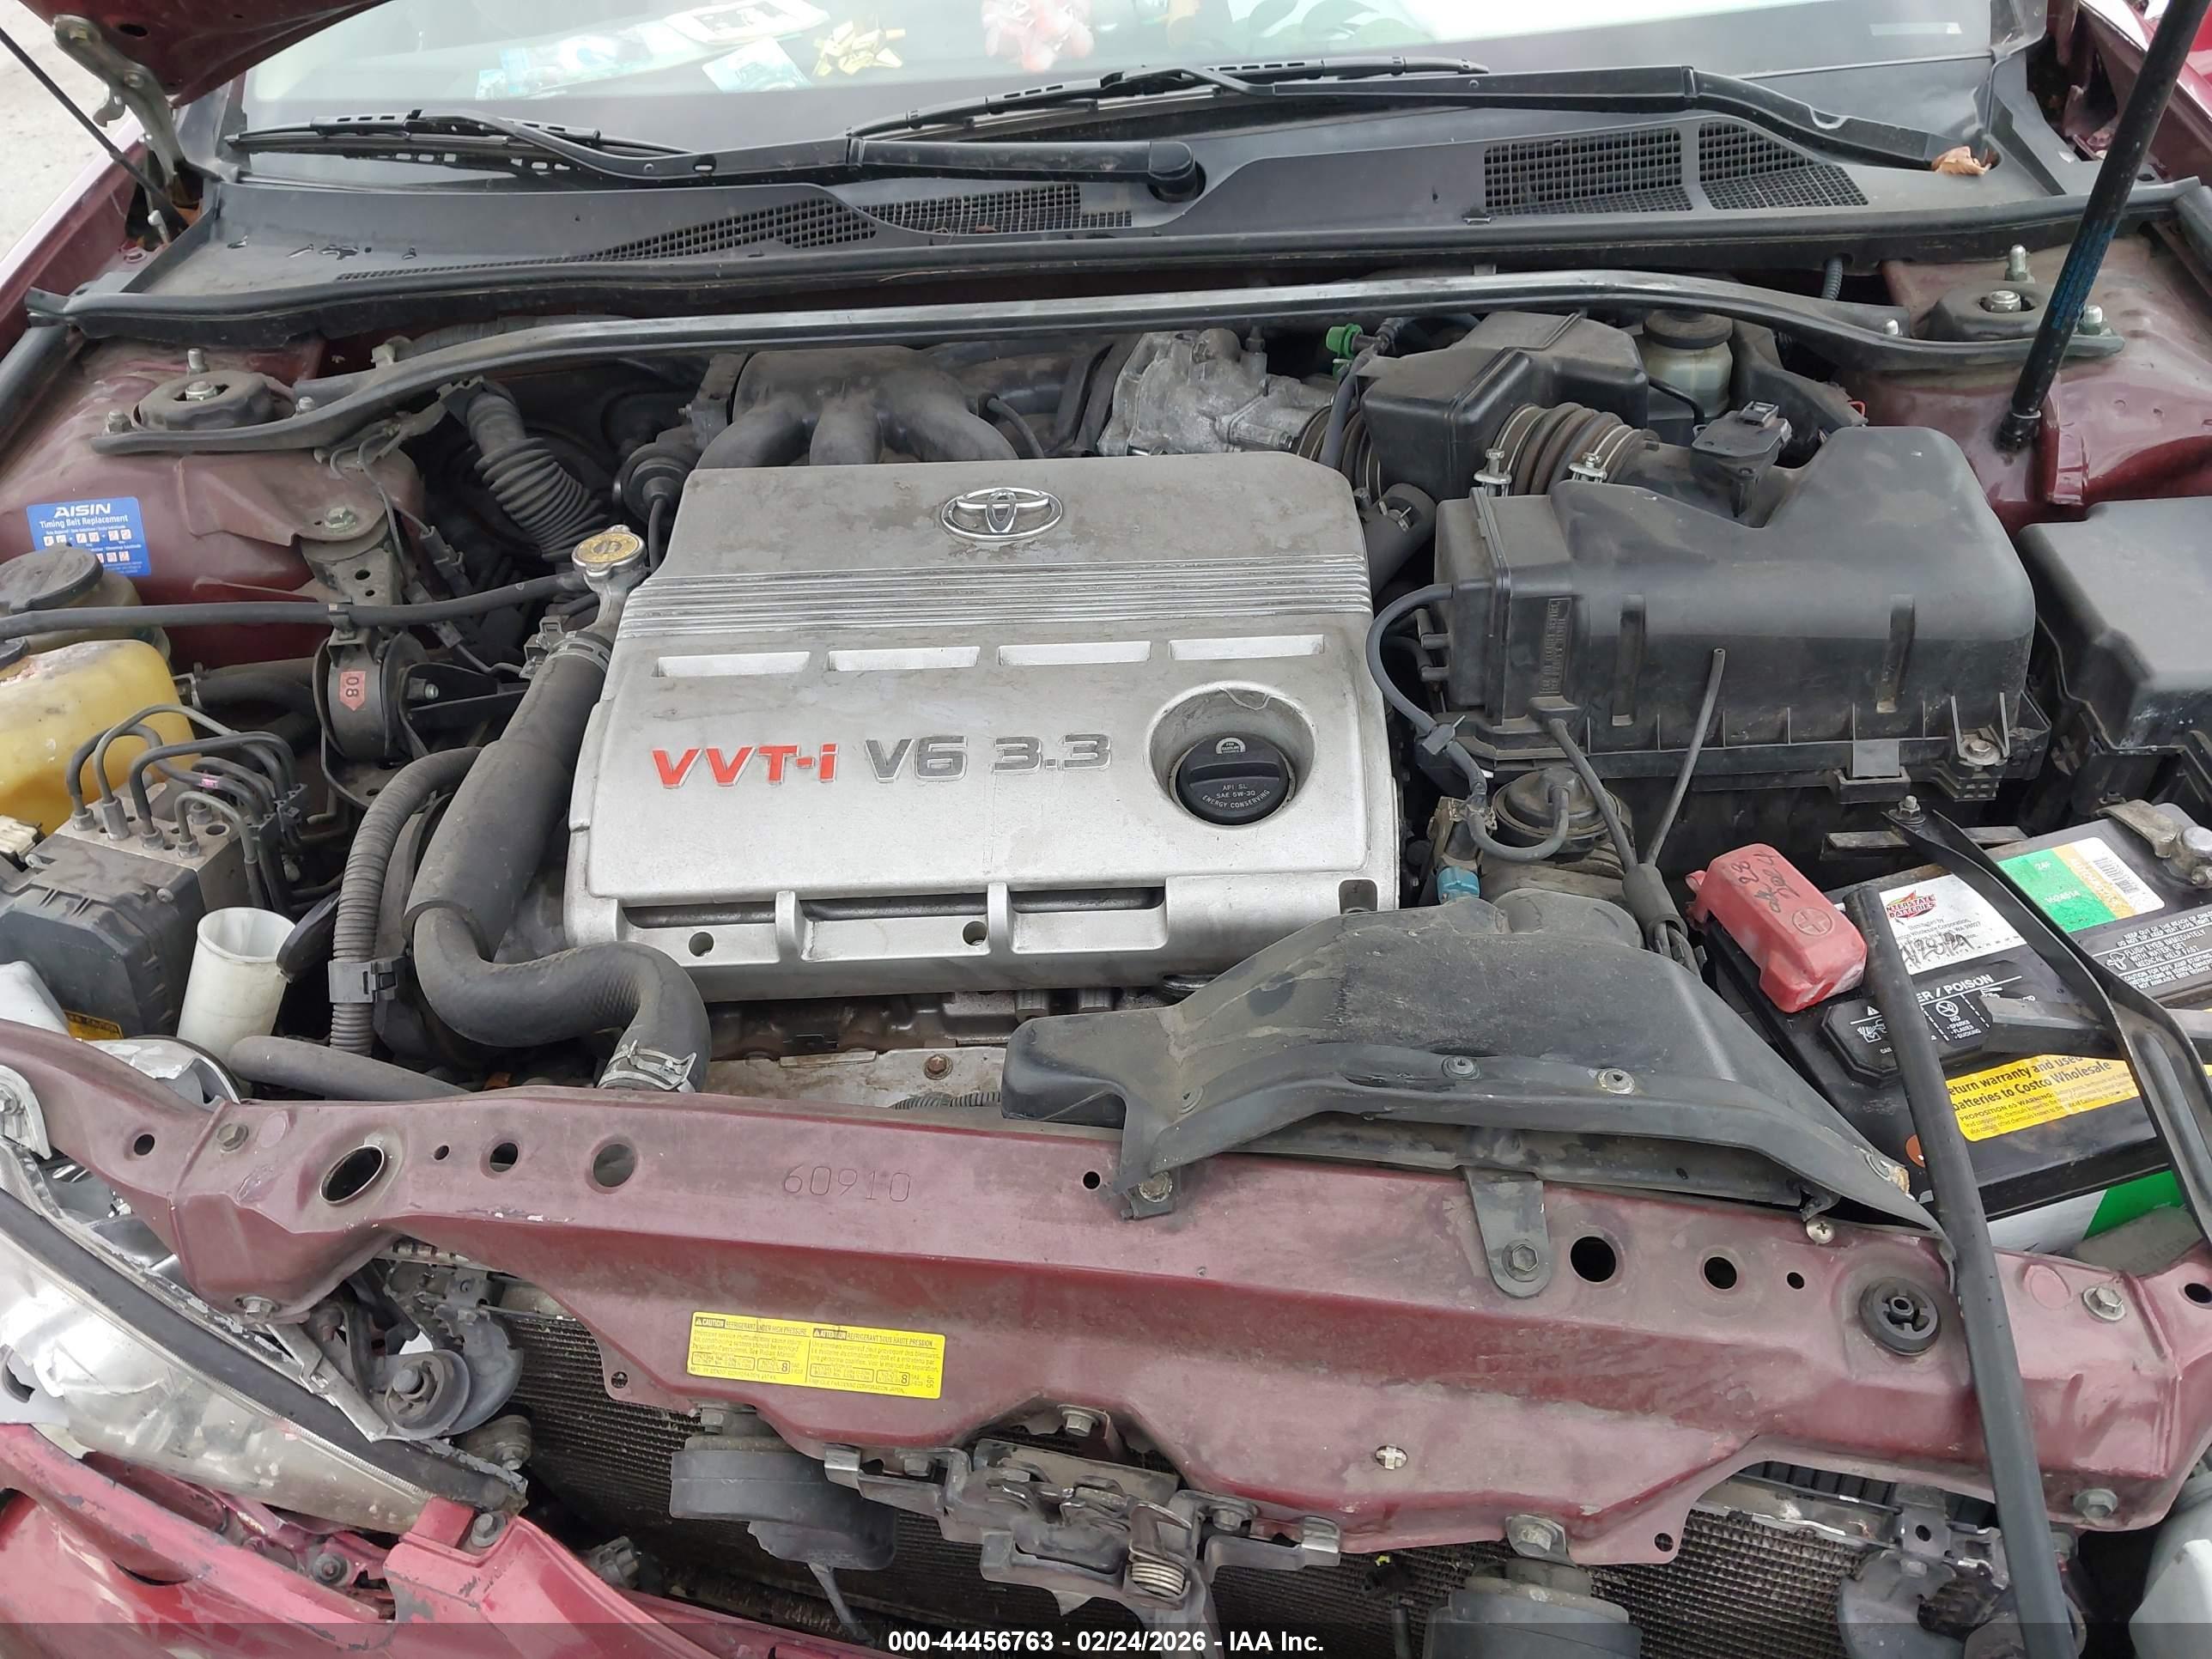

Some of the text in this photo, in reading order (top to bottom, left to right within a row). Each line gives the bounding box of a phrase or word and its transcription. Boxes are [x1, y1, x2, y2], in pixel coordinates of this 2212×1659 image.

[54, 503, 111, 519] AISIN
[40, 520, 65, 529] Timing
[82, 514, 129, 526] Replacement
[652, 733, 1112, 788] VVT-i V6 3.3
[1202, 789, 1270, 808] ENERGY CONSERVING
[1887, 894, 1936, 912] NTERSTATE
[1889, 902, 1936, 918] BATTERIES
[2124, 928, 2206, 957] FLUSH EYES IMMEDIATELY
[2129, 951, 2148, 963] WITH
[2172, 942, 2186, 951] GET
[2135, 945, 2199, 969] MEDICAL HELP FAST
[1942, 975, 1995, 994] POISON
[1948, 1080, 1979, 1096] eturn
[1979, 1066, 2032, 1088] warranty
[2033, 1060, 2054, 1073] and
[2001, 1087, 2014, 1098] to
[2014, 1078, 2052, 1095] Costco
[2051, 1060, 2112, 1085] Wholesale
[1960, 1104, 2008, 1121] PROPOSITION
[2017, 1091, 2055, 1107] WARNING:
[783, 1163, 911, 1202] 60910
[702, 1318, 725, 1328] CAUTION
[908, 1338, 933, 1347] PRESSION
[781, 1363, 788, 1372] 8
[901, 1374, 908, 1384] 8
